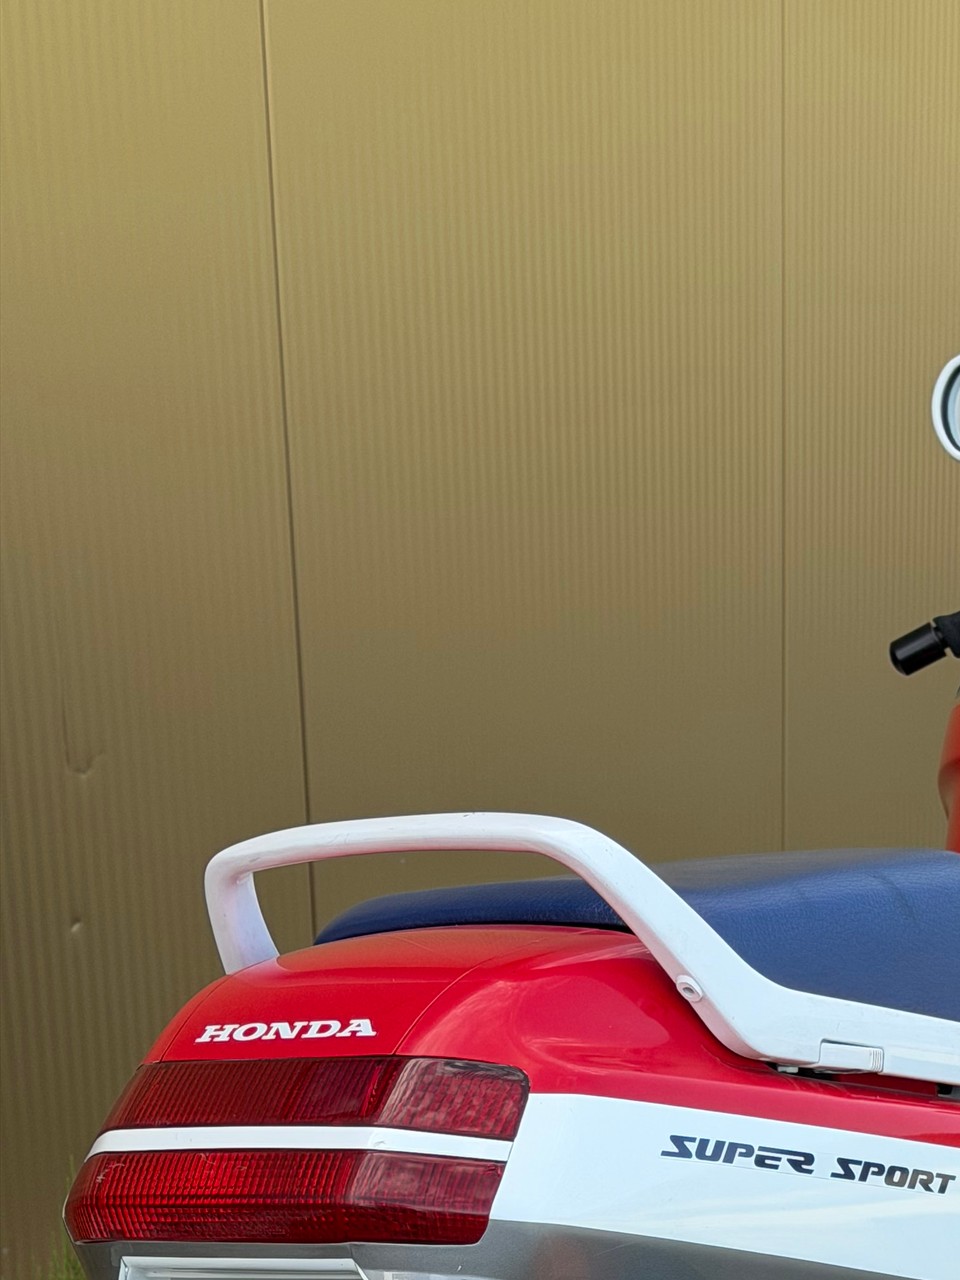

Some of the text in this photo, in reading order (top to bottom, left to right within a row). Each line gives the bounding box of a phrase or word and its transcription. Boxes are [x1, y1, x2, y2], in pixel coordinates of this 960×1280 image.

[194, 1018, 377, 1043] HONDA
[660, 1135, 957, 1195] SUPER SPORT
